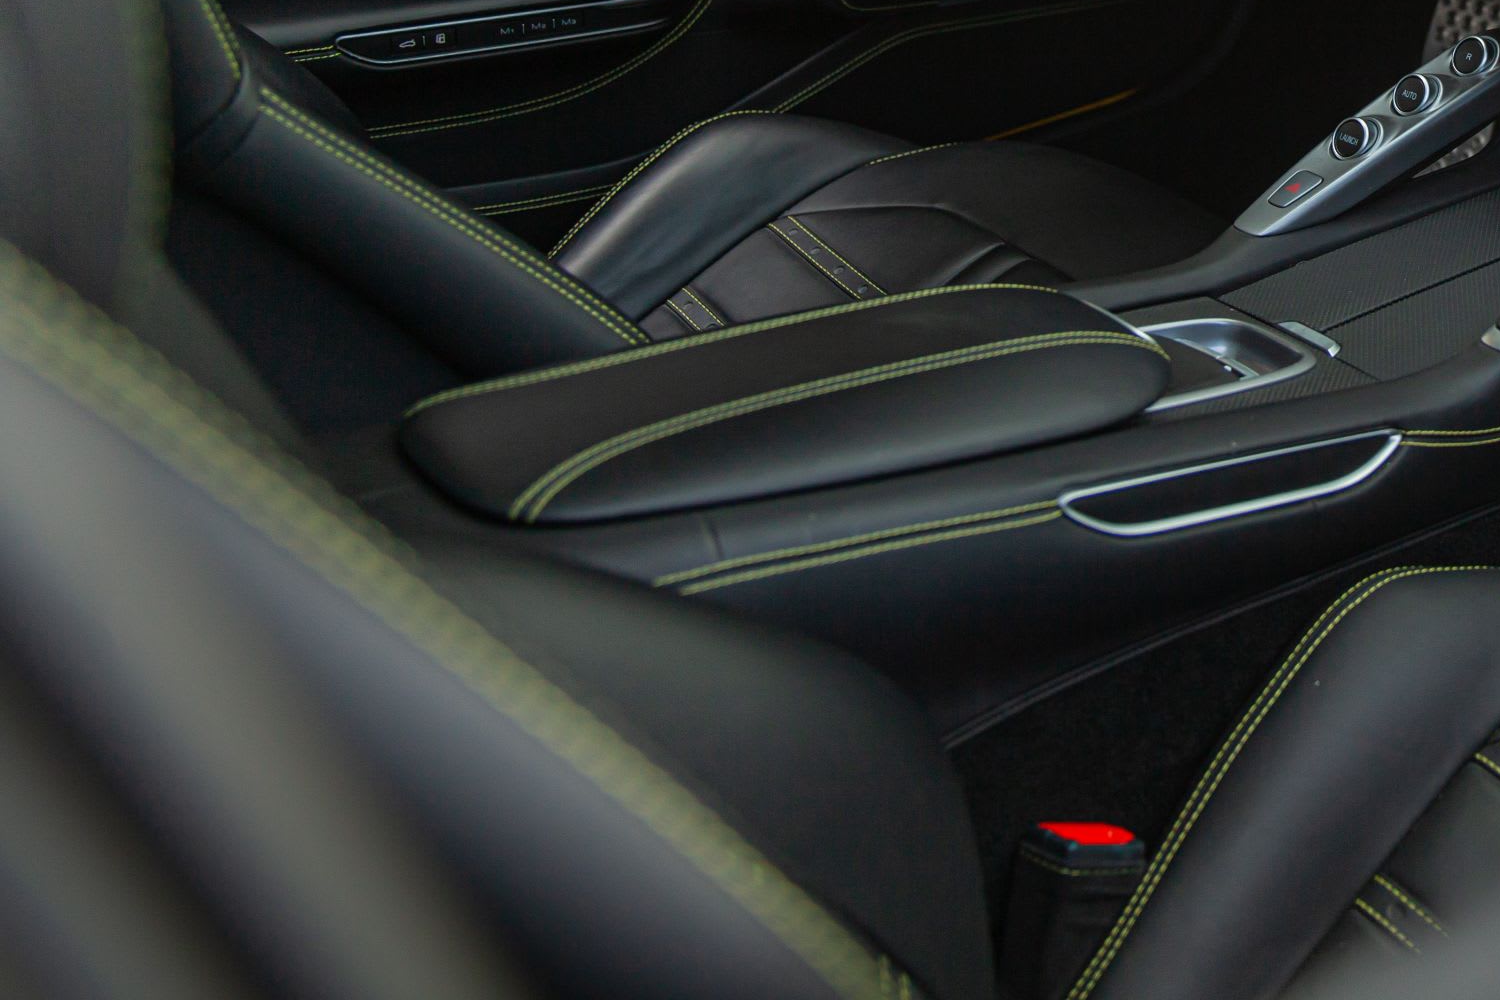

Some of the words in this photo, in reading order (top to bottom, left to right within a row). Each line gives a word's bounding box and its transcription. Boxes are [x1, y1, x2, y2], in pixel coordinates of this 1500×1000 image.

[1465, 52, 1473, 61] R
[1401, 89, 1418, 101] AUTO
[1339, 132, 1360, 146] LAUNCH
